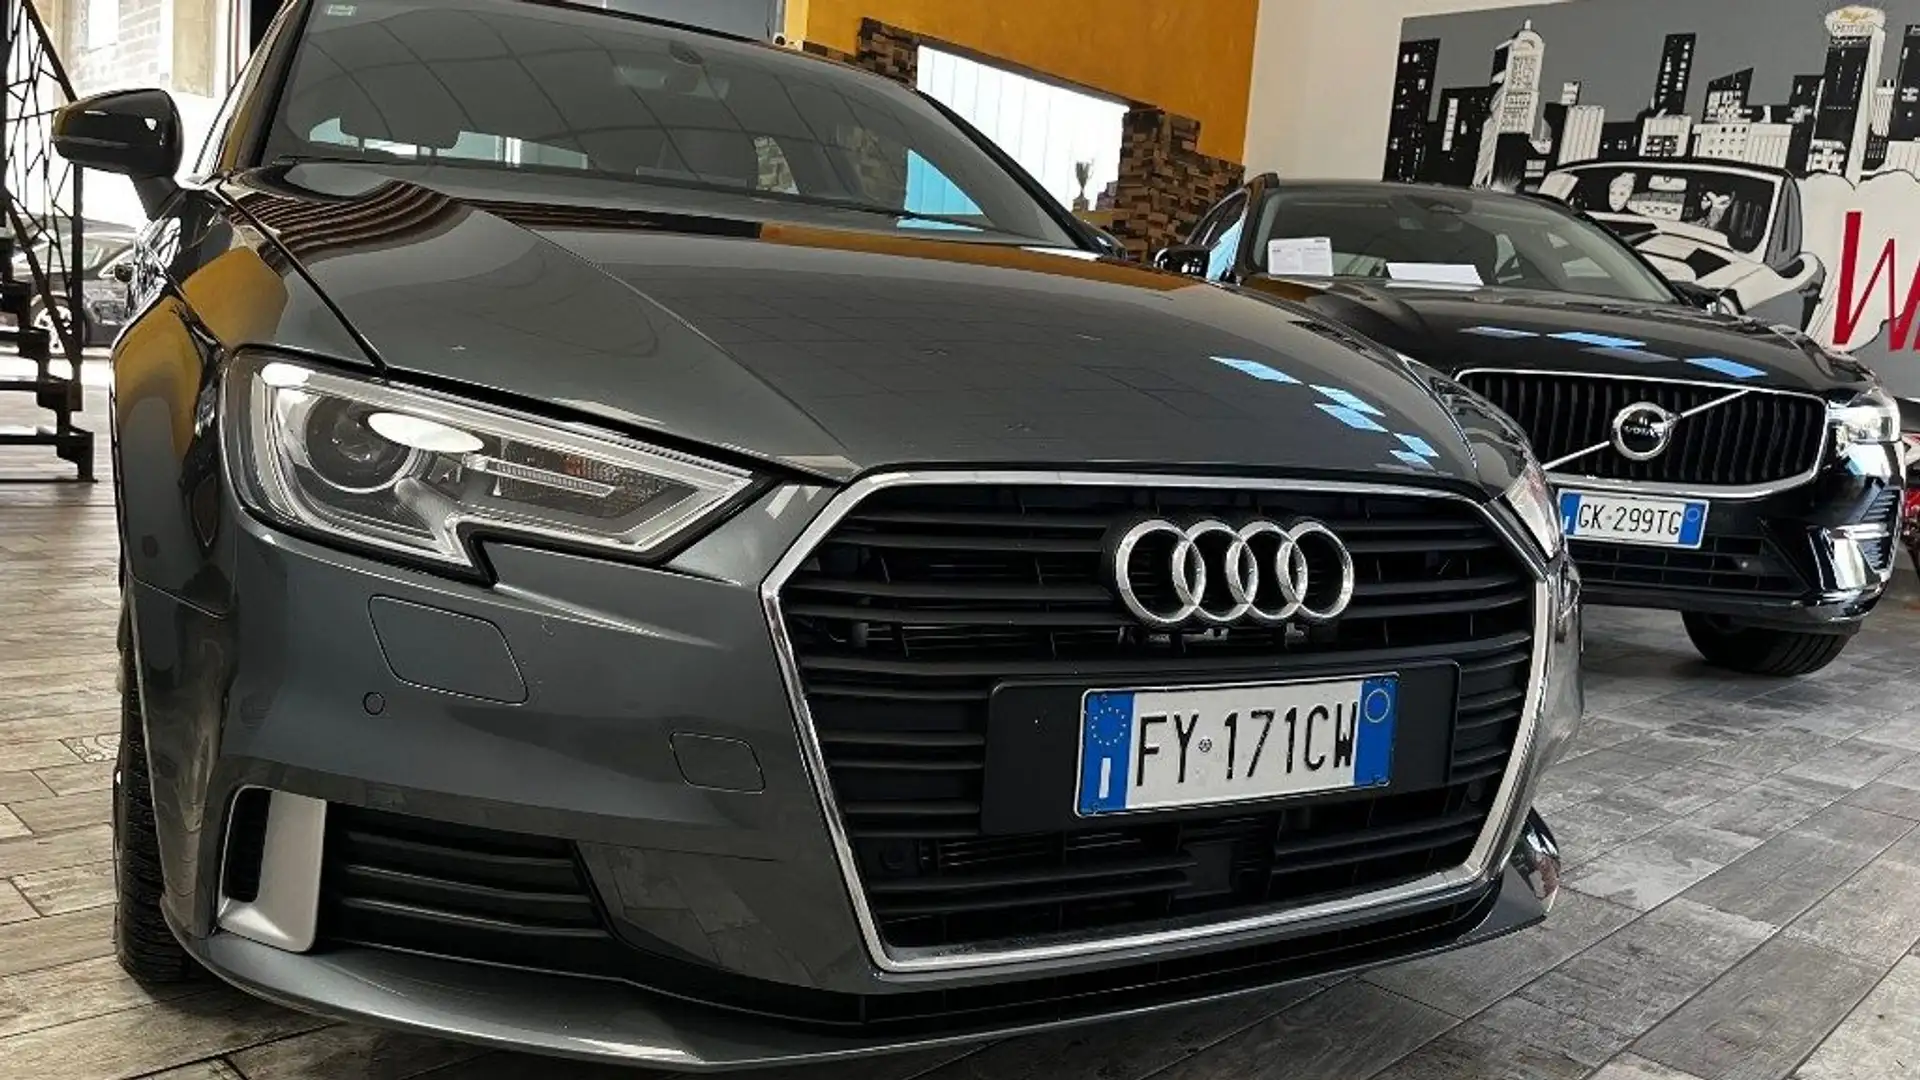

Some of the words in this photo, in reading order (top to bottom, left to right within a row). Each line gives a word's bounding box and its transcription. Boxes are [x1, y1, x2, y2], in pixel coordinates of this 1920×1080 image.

[1832, 211, 1920, 351] W
[1579, 504, 1606, 529] GK
[1613, 506, 1682, 535] 299TG
[1136, 713, 1199, 786] FY
[1224, 701, 1358, 780] 171CW
